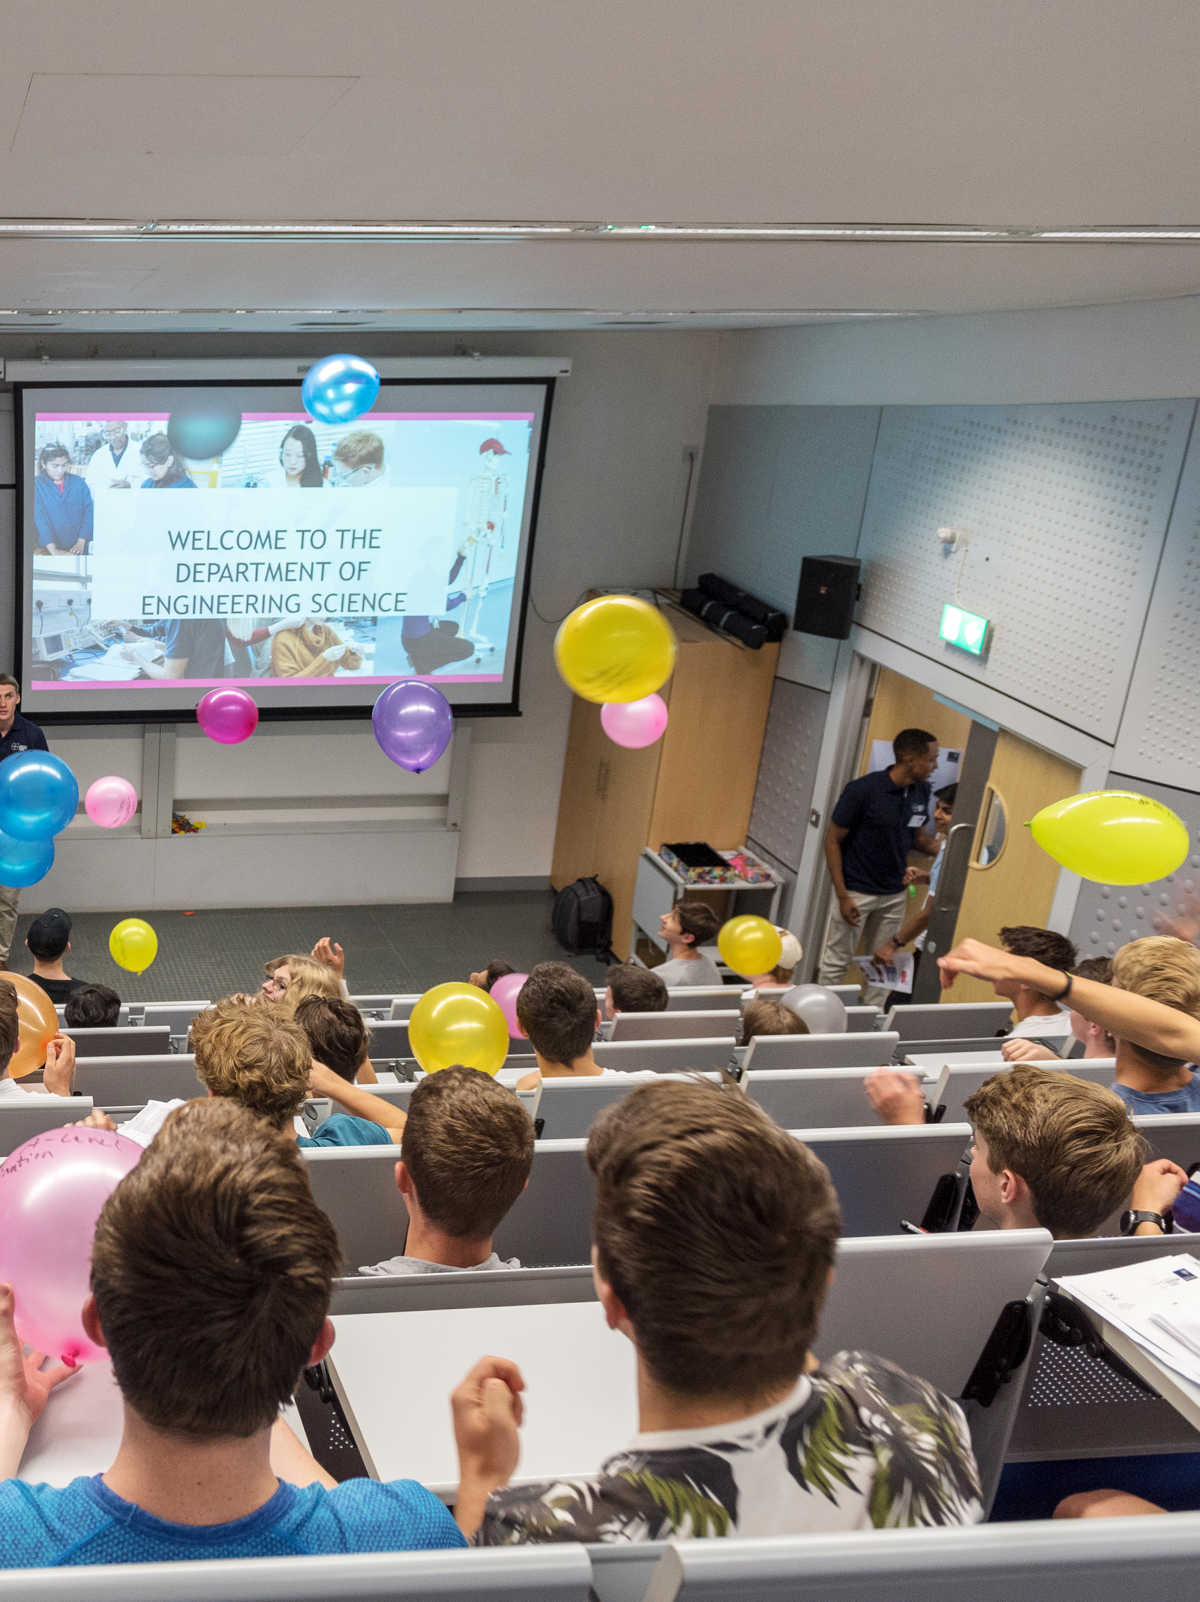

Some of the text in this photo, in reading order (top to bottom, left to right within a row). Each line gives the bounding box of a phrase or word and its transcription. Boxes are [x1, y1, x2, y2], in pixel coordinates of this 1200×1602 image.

[167, 528, 383, 551] WELCOME TO THE
[175, 561, 371, 583] DEPARTMENT OF
[140, 592, 409, 616] ENGINEERING SCIENCE
